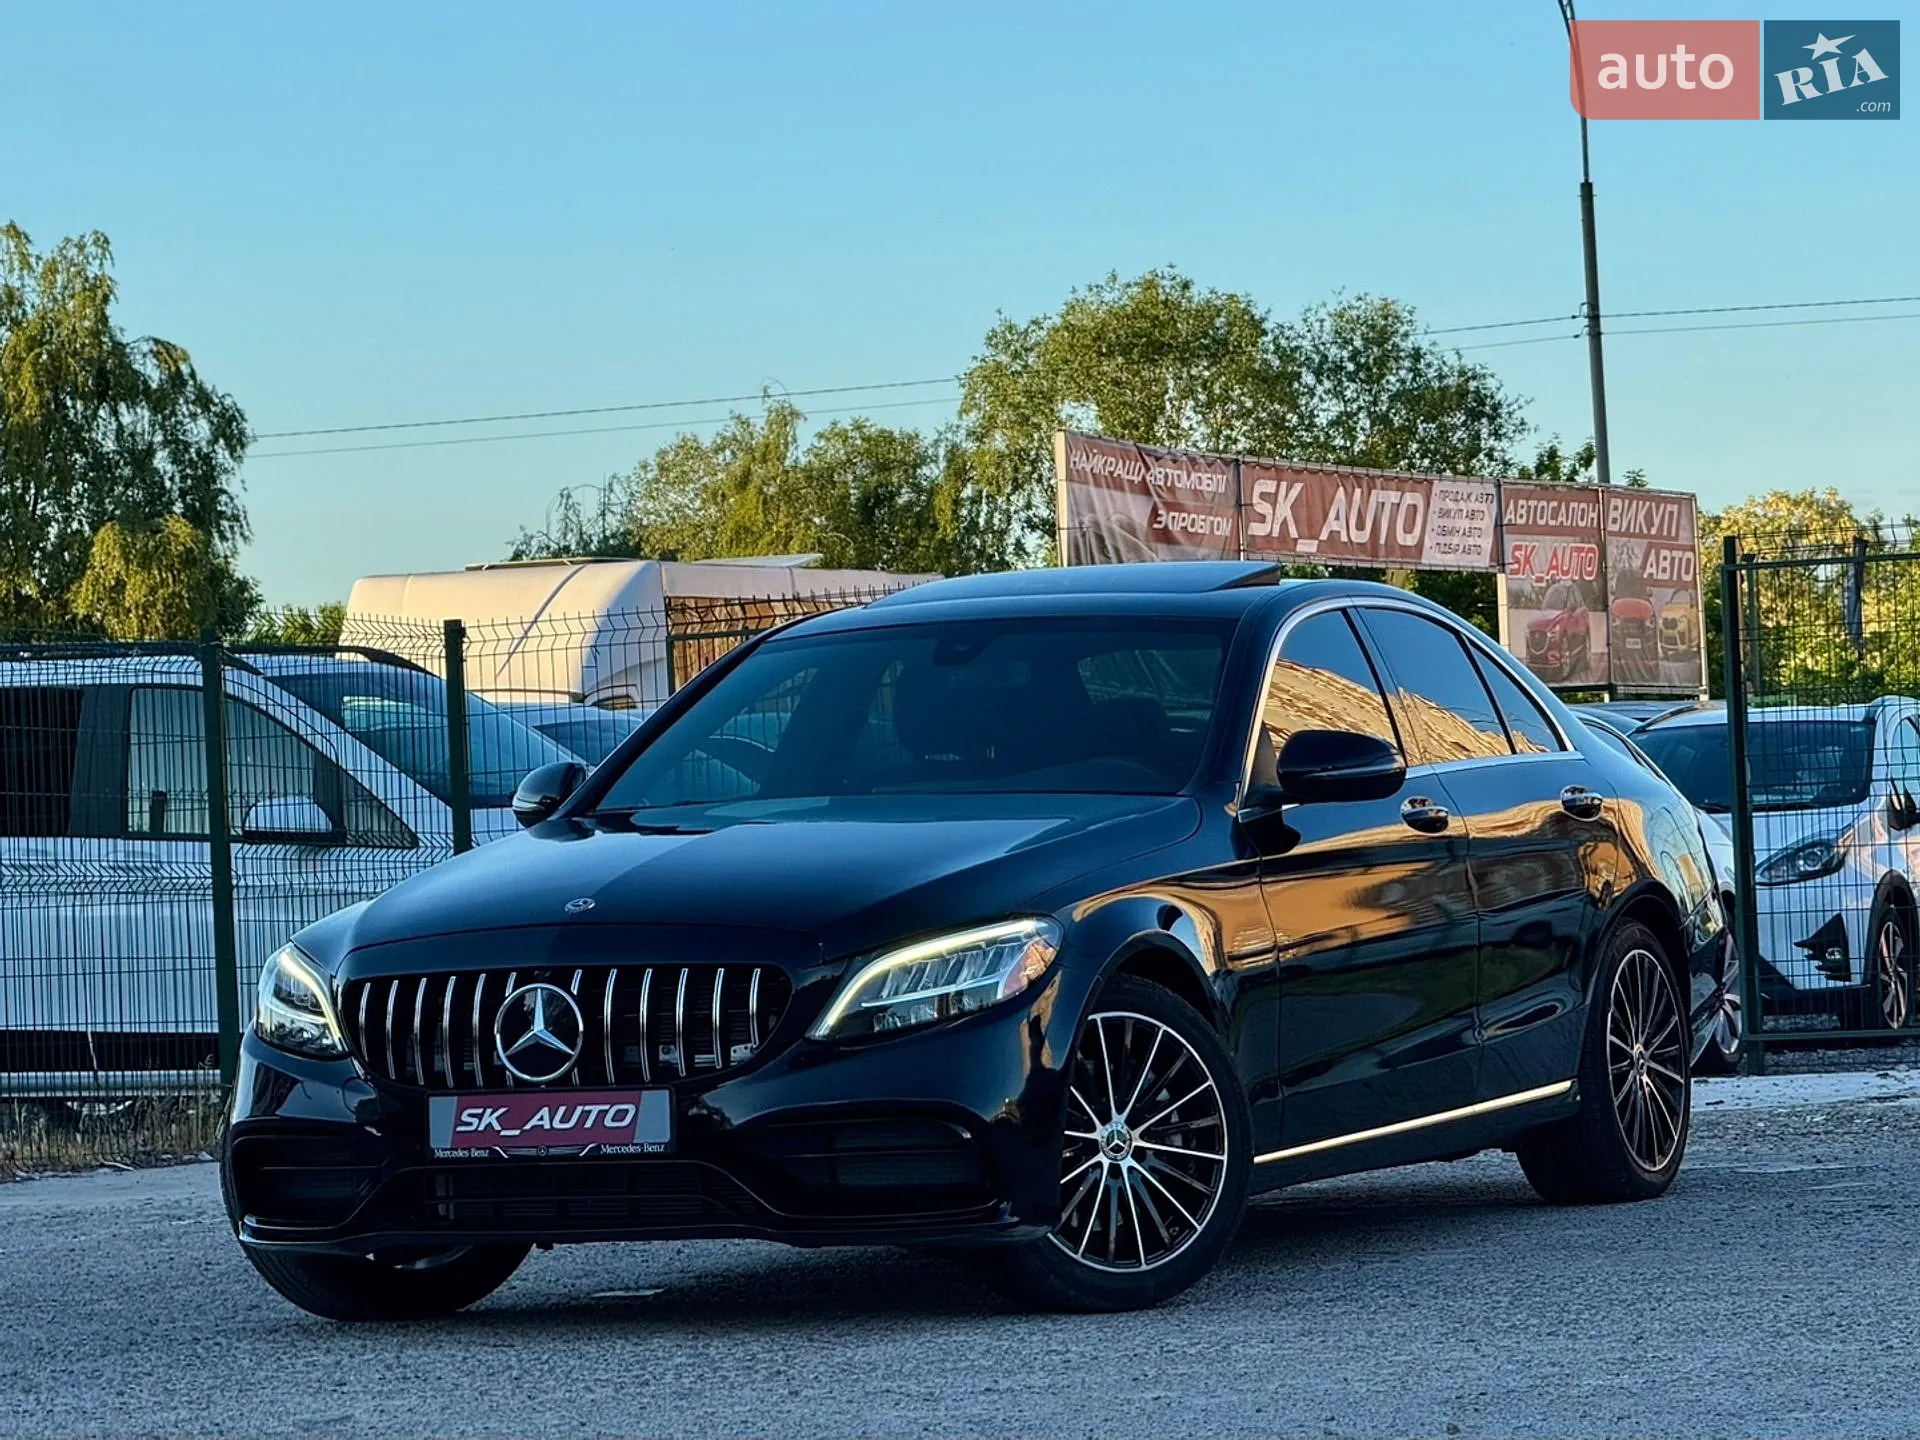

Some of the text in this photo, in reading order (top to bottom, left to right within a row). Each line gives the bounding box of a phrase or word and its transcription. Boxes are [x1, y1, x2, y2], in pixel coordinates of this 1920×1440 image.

[1474, 492, 1494, 504] АВТО
[1247, 479, 1424, 554] SK_AUTO
[1465, 509, 1485, 521] АВТО
[1504, 499, 1599, 528] АВТОСАЛОН
[1608, 498, 1679, 537] ВИКУП
[1461, 526, 1482, 538] АВТО
[1461, 544, 1482, 556] АВТО
[1508, 542, 1600, 586] SK_AUTO
[1643, 548, 1695, 582] АВТО
[456, 1103, 636, 1136] SK_AUTO
[600, 1142, 666, 1154] Mercedes-Benz
